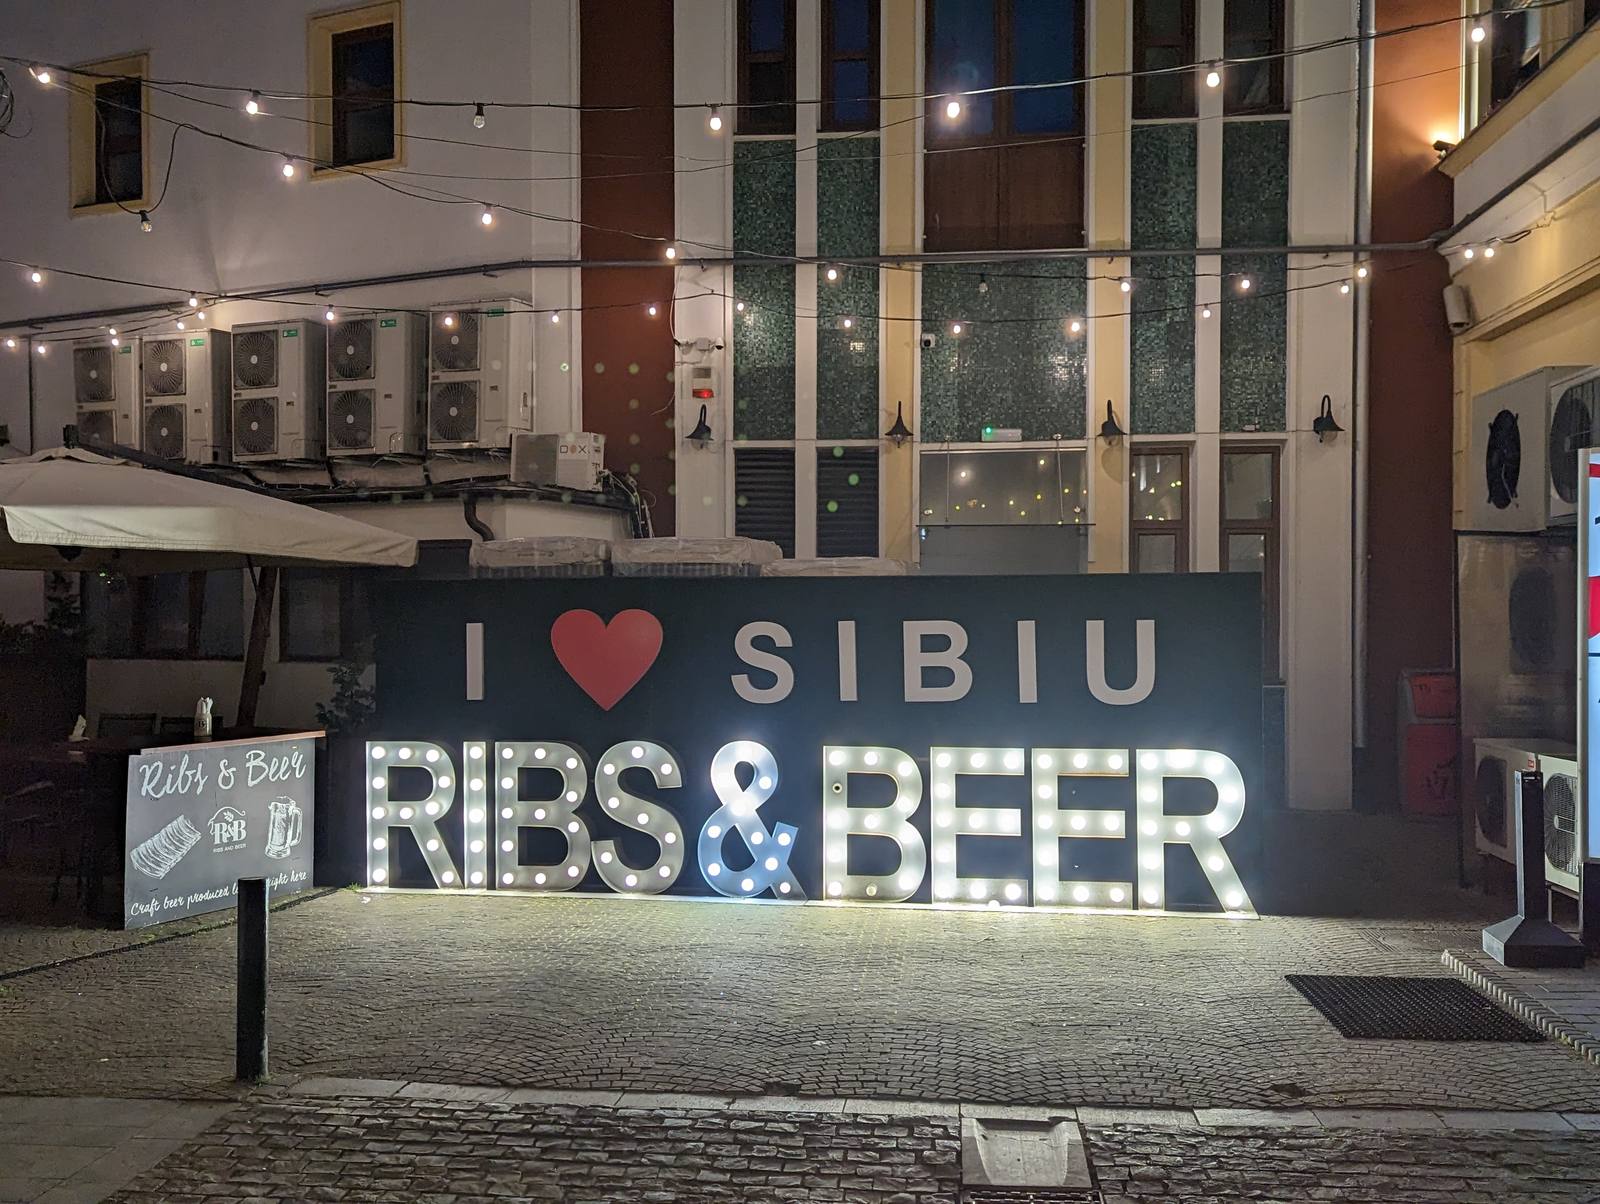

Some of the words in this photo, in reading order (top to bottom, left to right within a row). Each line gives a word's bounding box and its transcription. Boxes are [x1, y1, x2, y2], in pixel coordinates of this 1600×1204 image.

[466, 622, 485, 701] I
[730, 619, 1156, 706] SIBIU
[139, 754, 209, 799] Ribs
[217, 758, 237, 790] &
[245, 750, 307, 788] Beer
[366, 740, 685, 895] RIBS
[697, 740, 807, 902] &
[823, 745, 1260, 920] BEER
[130, 896, 160, 917] Craft
[163, 895, 185, 910] beer
[186, 885, 230, 909] produced
